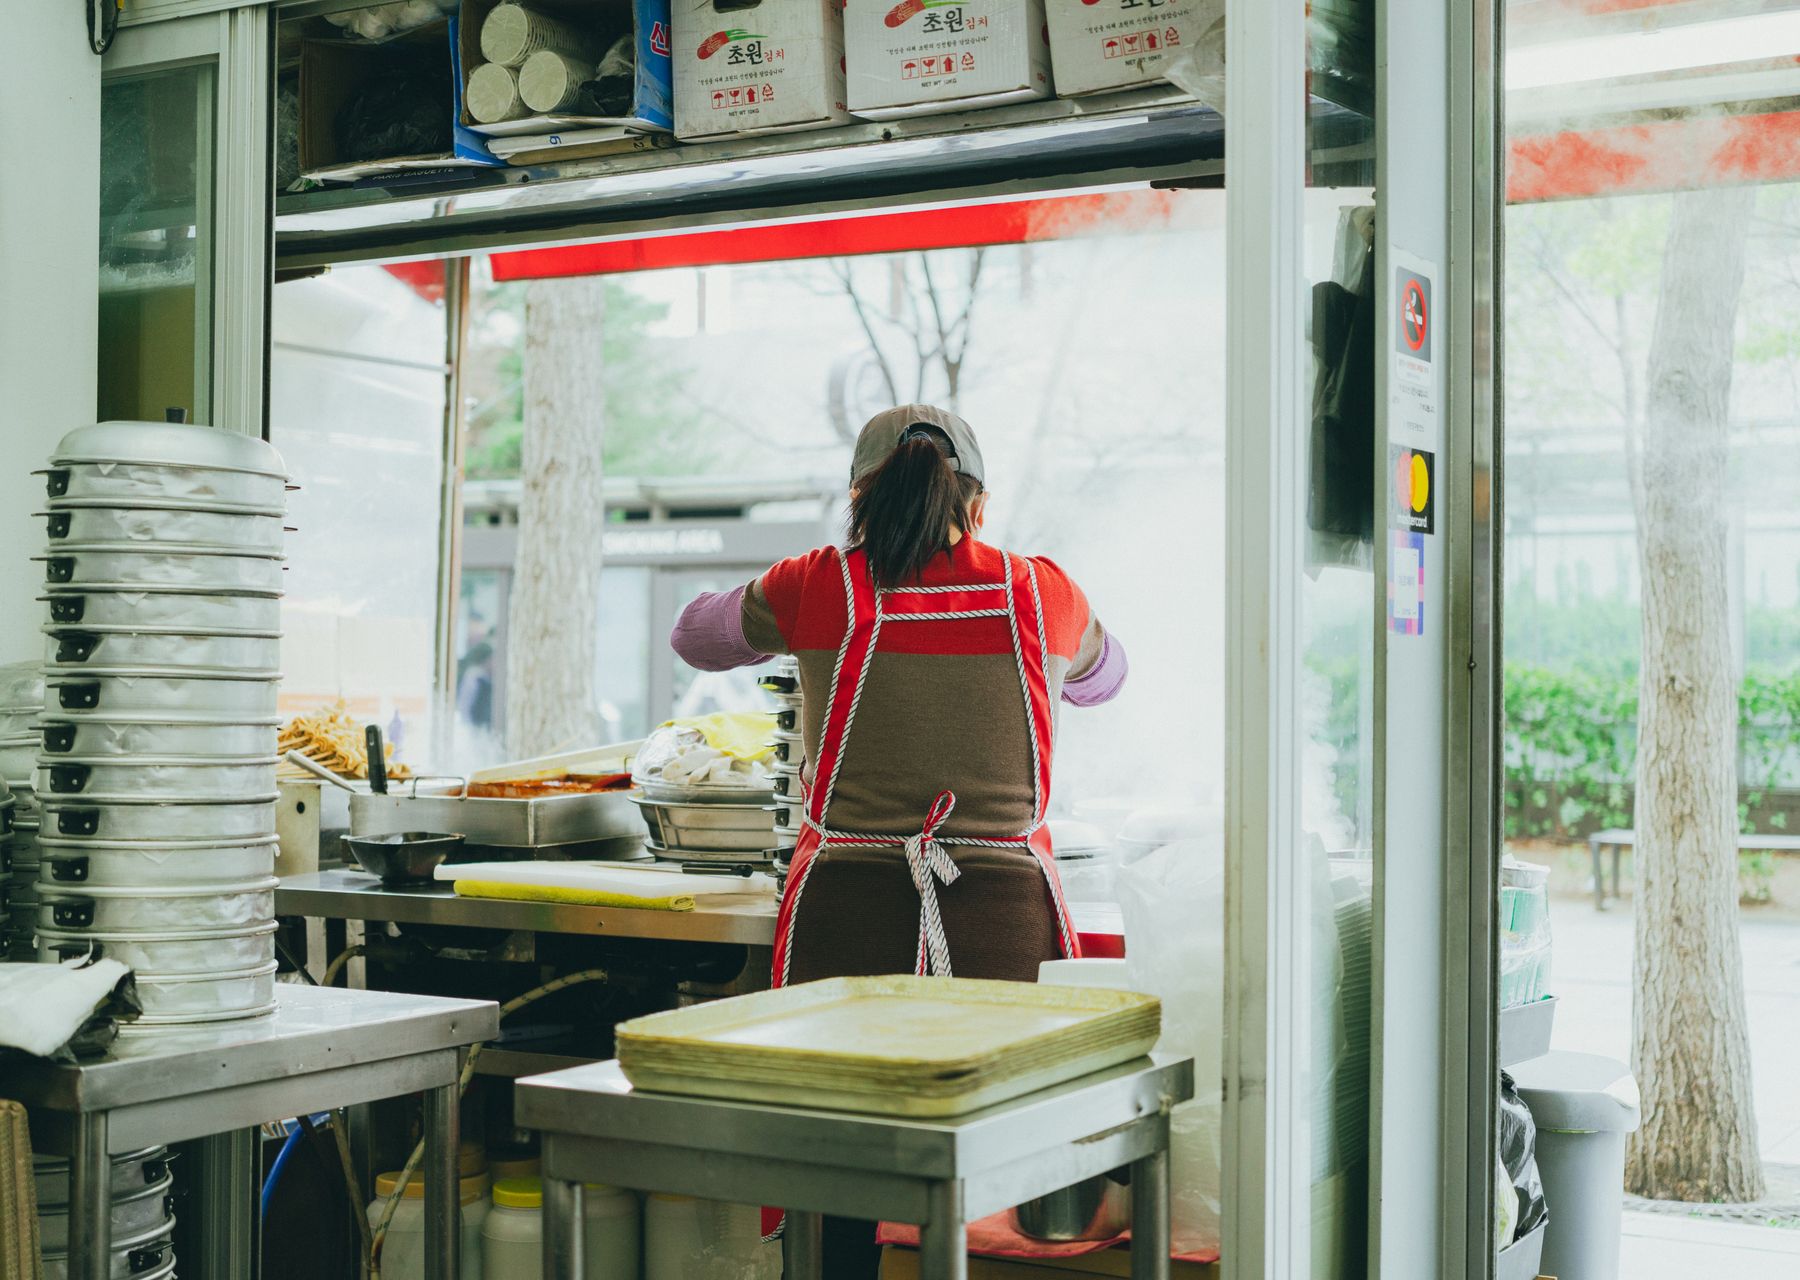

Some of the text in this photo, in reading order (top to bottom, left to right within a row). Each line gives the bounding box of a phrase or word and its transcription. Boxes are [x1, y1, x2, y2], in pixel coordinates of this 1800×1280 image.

[922, 7, 988, 33] 초원 김치
[727, 40, 785, 65] 초원 김치
